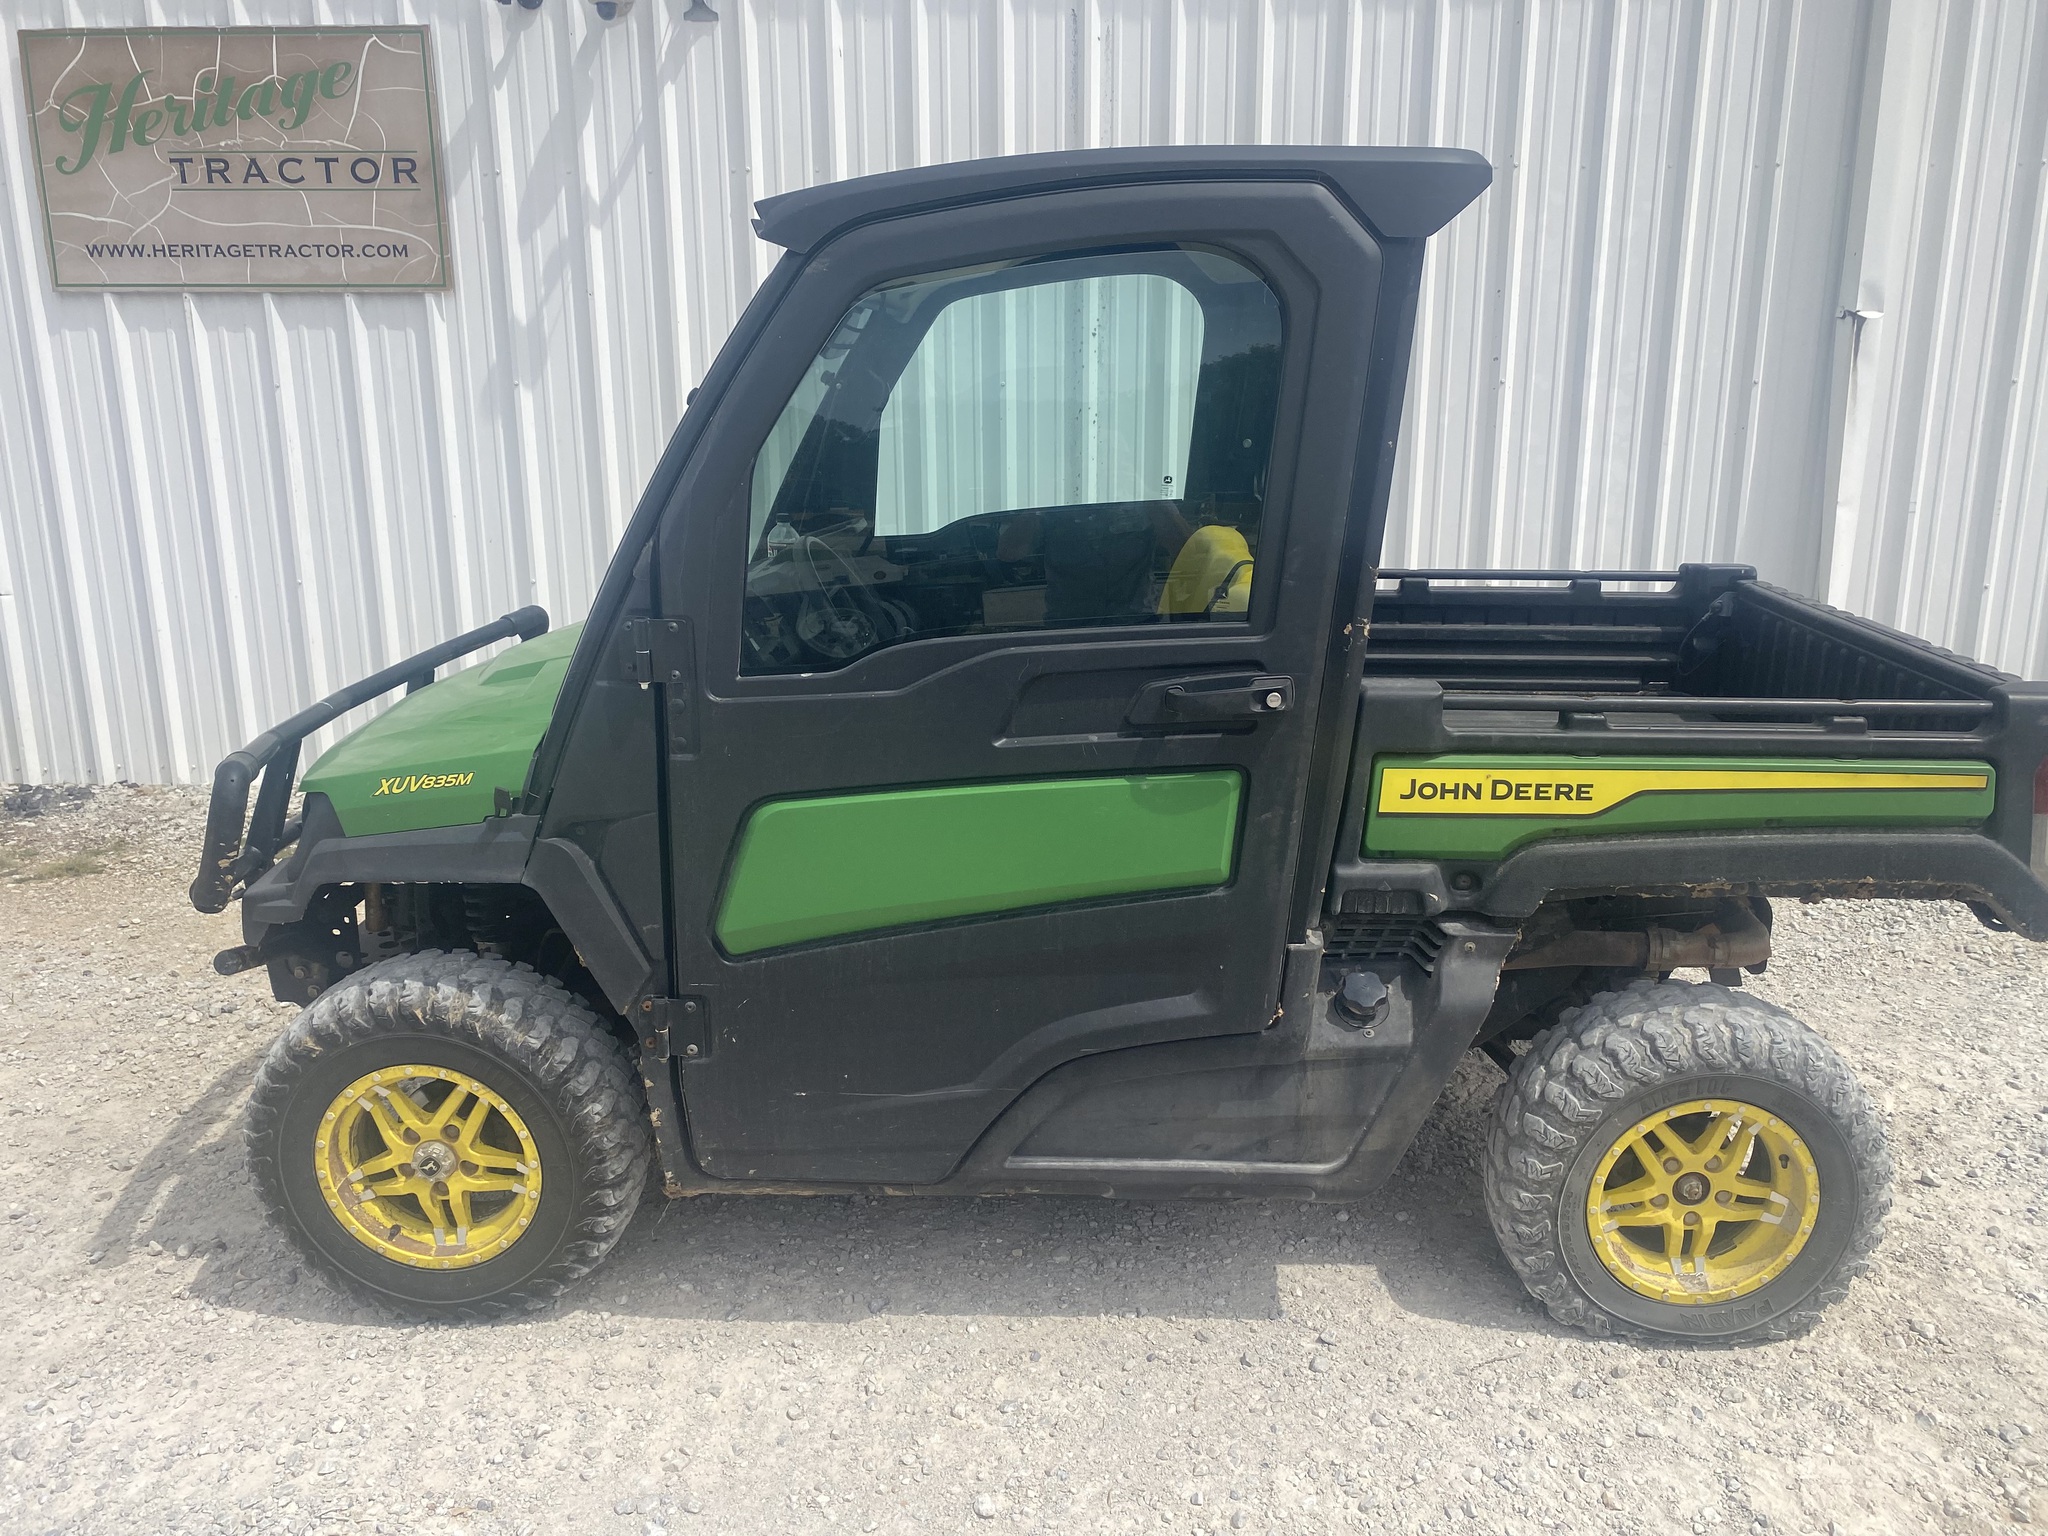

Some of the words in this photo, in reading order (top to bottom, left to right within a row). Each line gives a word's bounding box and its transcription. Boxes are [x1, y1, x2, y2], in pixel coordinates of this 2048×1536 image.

[55, 61, 358, 176] Heritage
[168, 157, 419, 185] TRACTOR
[85, 243, 409, 259] WWW.HERITAGETRACTOR.COM
[371, 771, 475, 797] XUV835M
[1400, 778, 1482, 801] JOHN
[1490, 779, 1595, 802] DEERE
